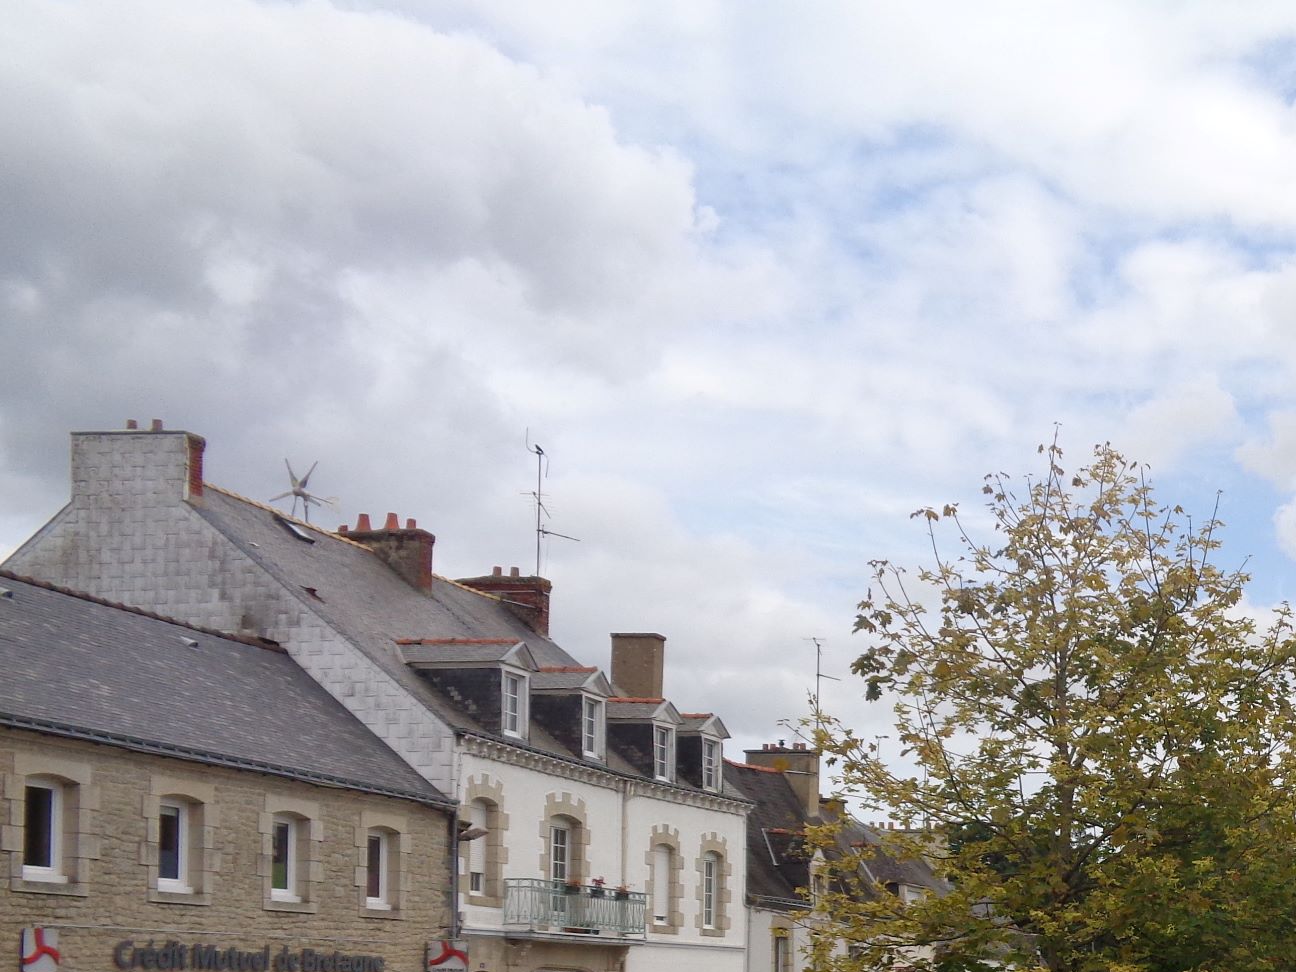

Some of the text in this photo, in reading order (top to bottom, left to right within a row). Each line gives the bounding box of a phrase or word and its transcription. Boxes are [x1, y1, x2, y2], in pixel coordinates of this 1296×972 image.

[114, 939, 187, 971] Crédit
[191, 943, 270, 972] Mutuel
[275, 945, 300, 972] de
